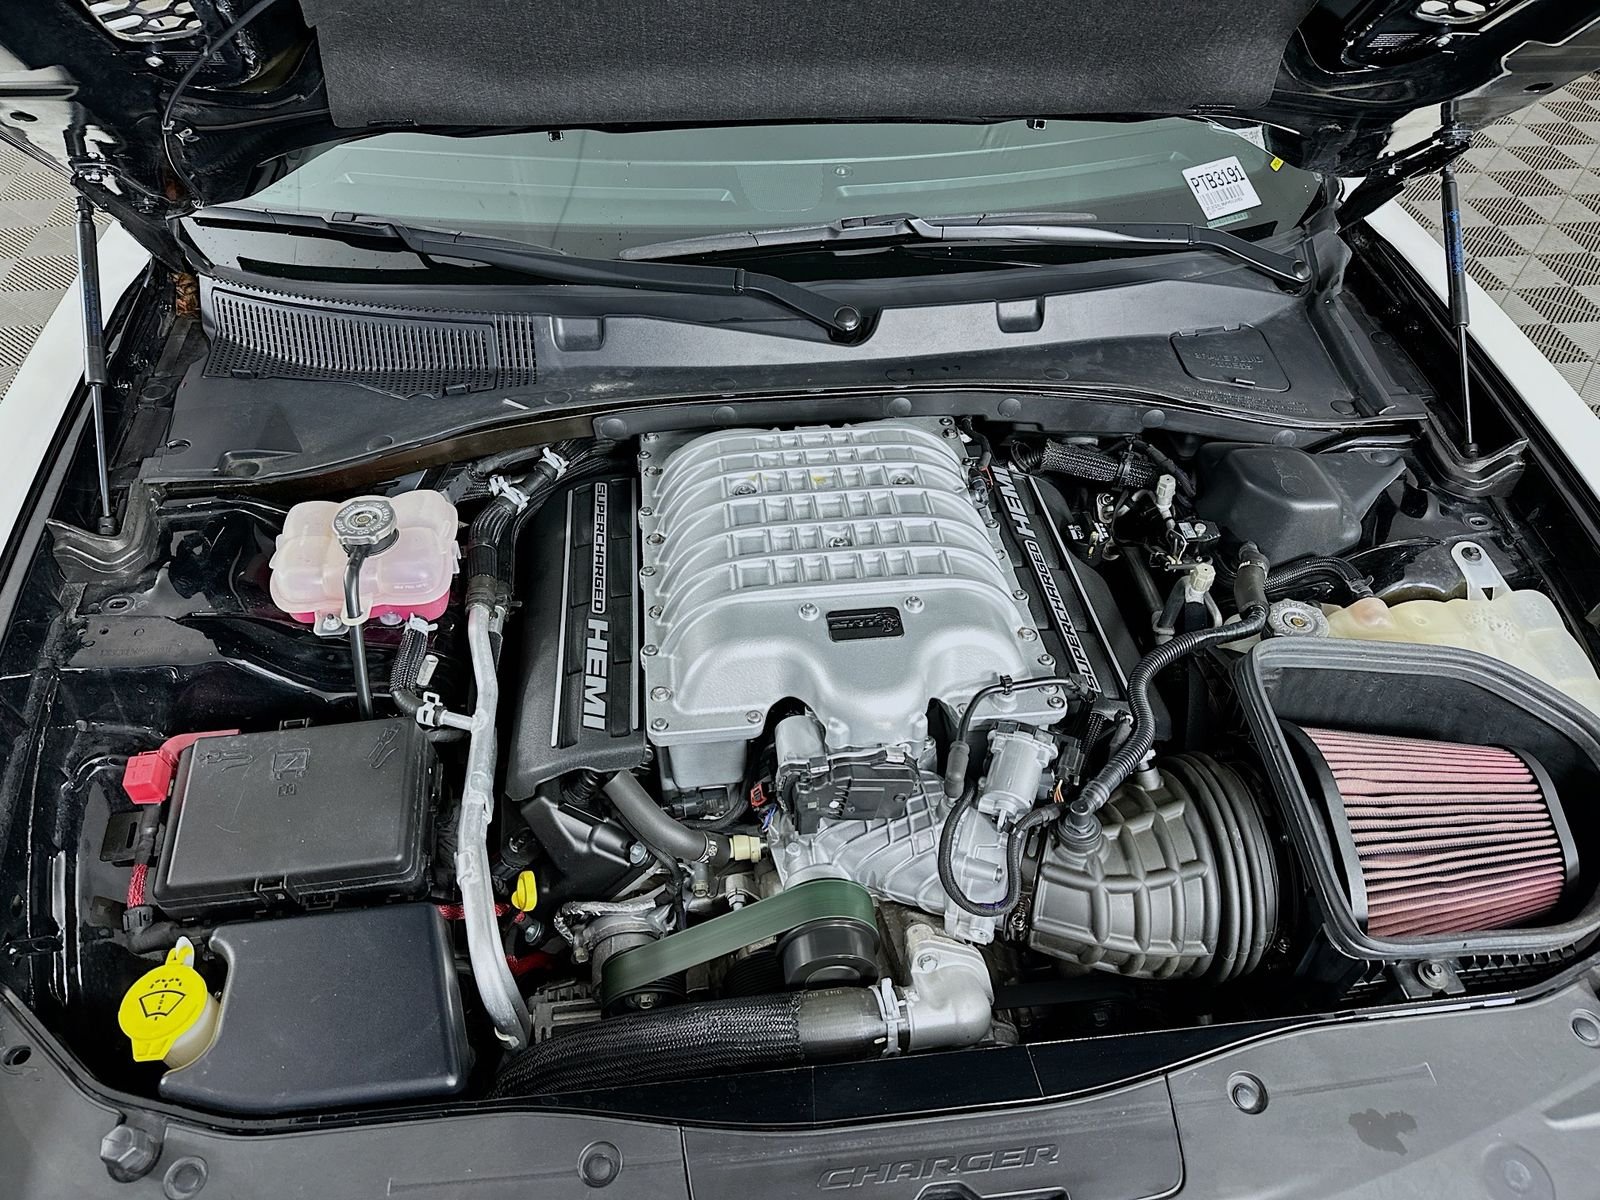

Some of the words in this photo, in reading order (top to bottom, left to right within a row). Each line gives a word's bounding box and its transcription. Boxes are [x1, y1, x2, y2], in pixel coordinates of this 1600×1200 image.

[1190, 165, 1245, 194] PTB3191
[991, 465, 1037, 538] HEMI
[591, 482, 608, 614] SUPERCHARGED
[1026, 540, 1102, 692] SUPERCHARGED
[583, 618, 608, 730] HEMI
[816, 1143, 1061, 1191] CHARGER
